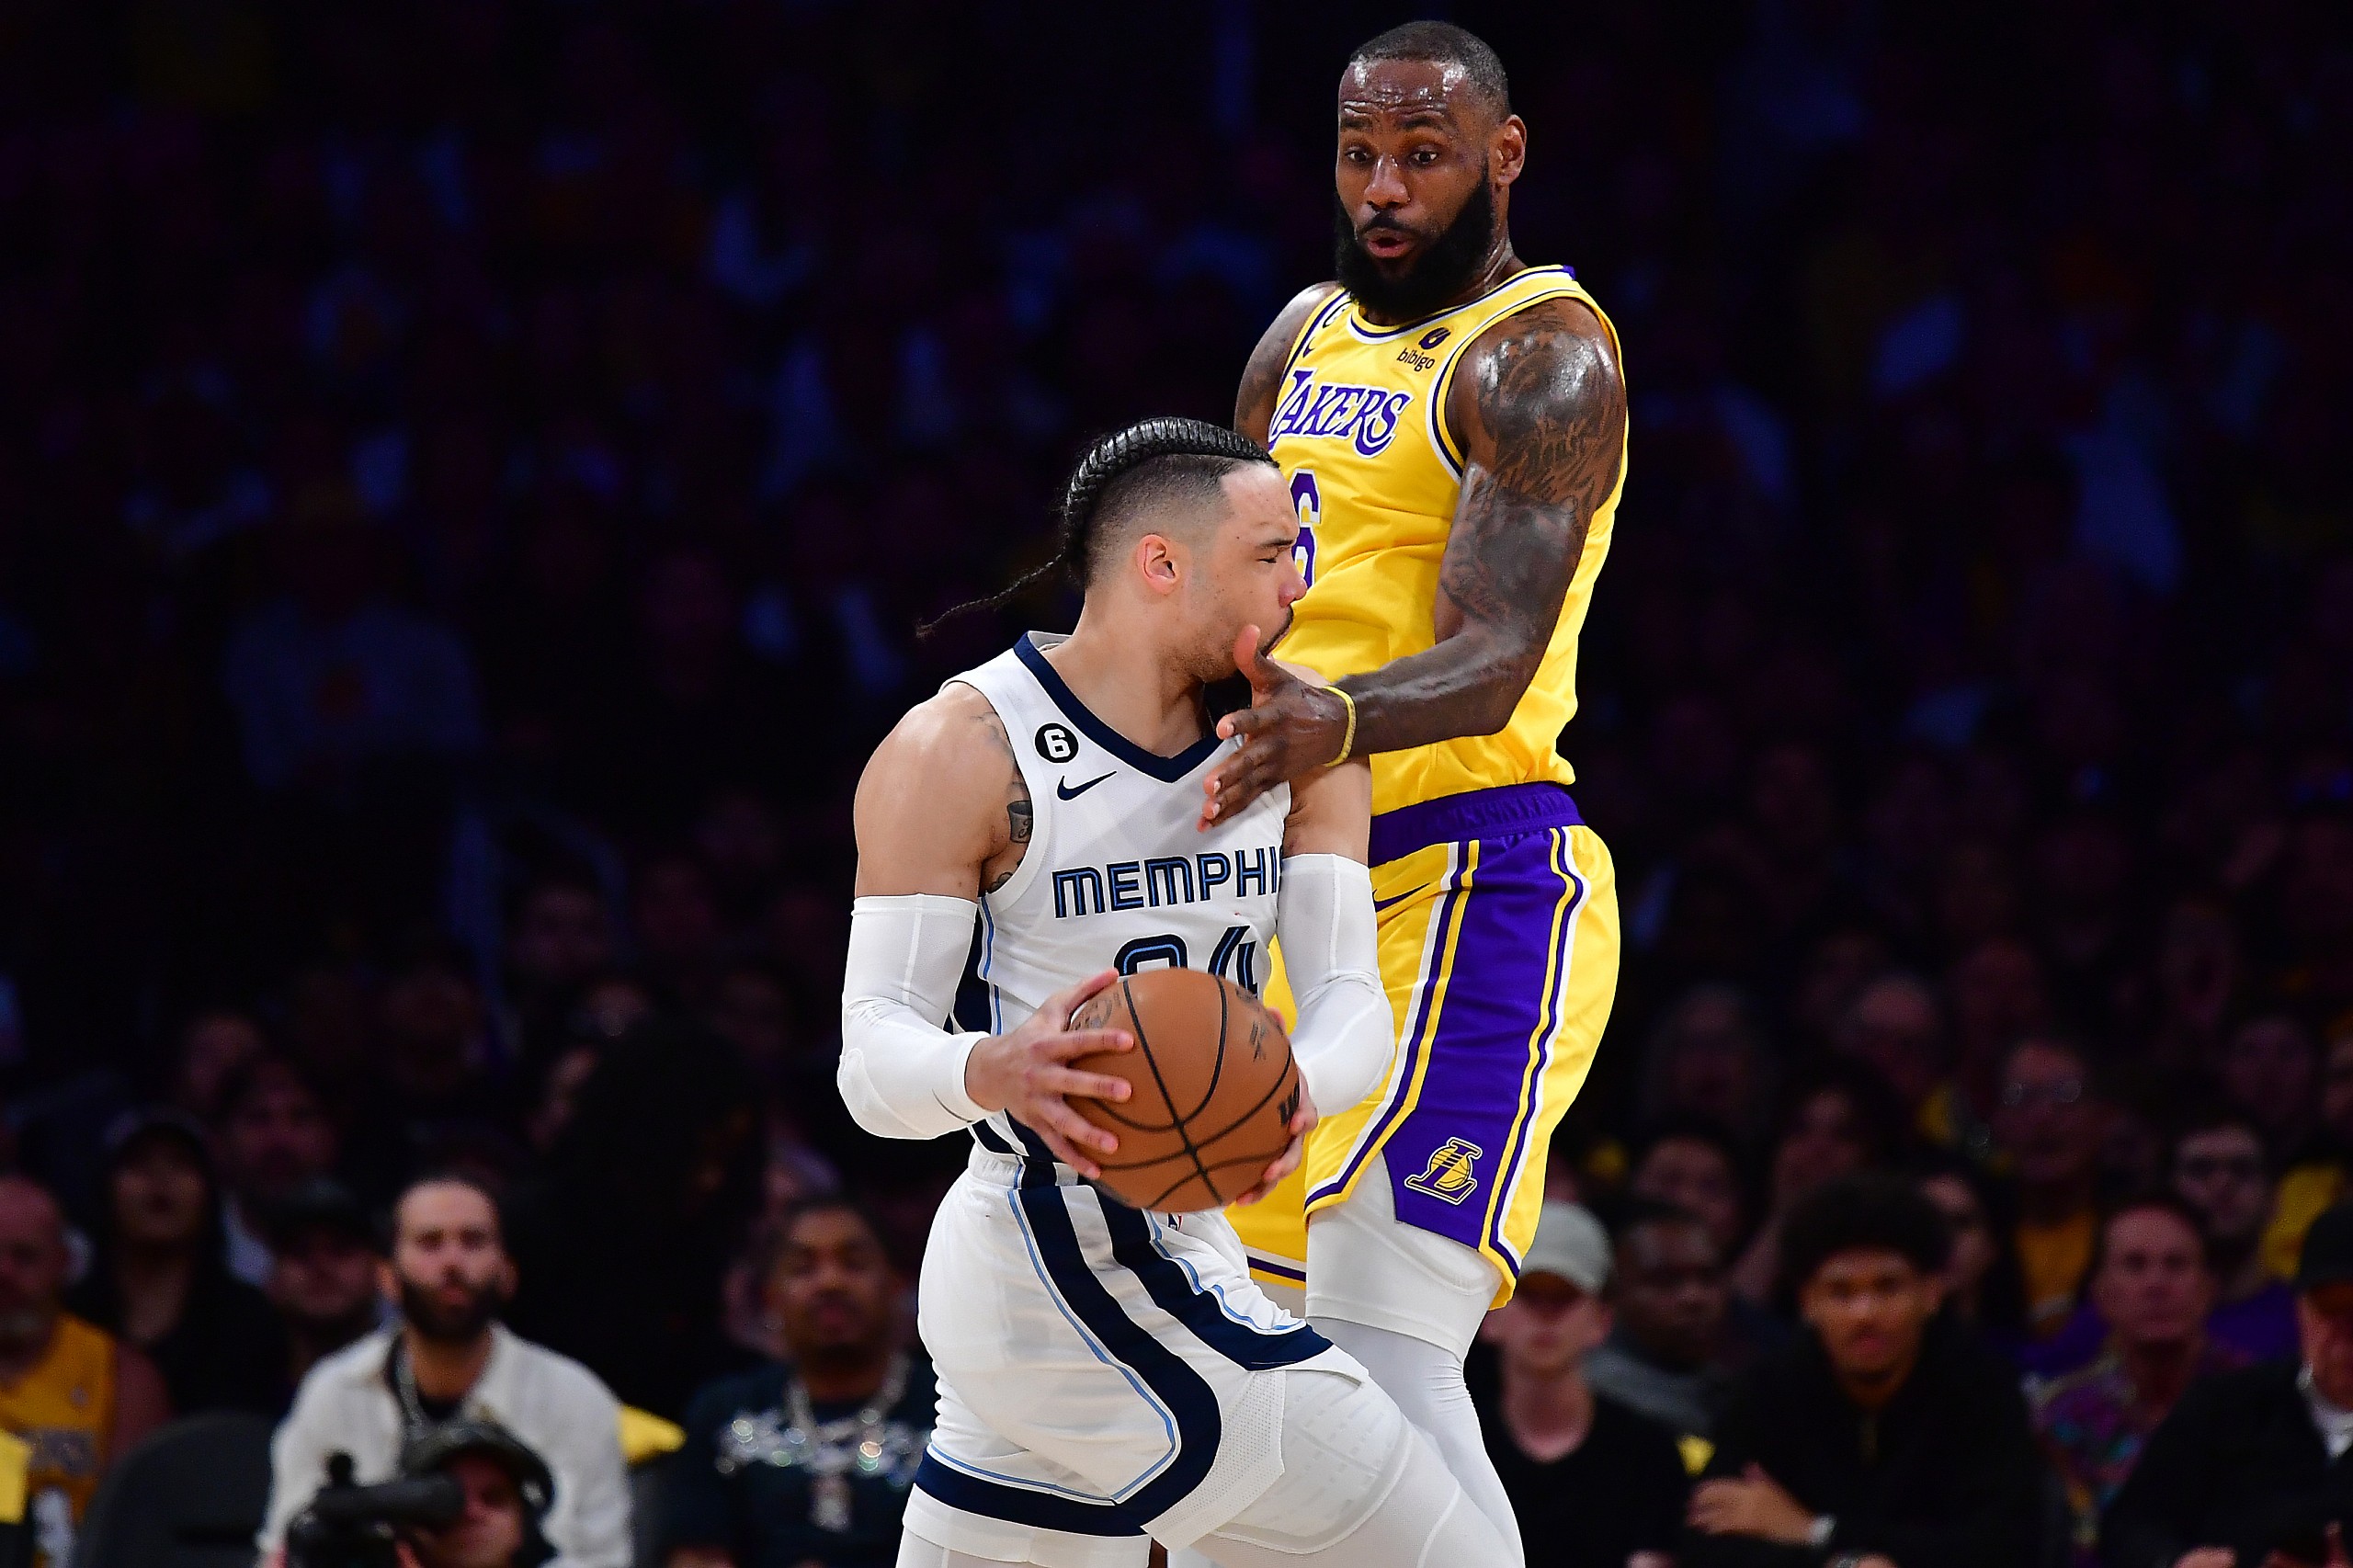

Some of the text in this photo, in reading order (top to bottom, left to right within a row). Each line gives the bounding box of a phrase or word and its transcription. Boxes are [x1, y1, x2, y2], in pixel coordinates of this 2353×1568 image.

[1396, 347, 1436, 372] bibigo
[1043, 728, 1071, 759] 6
[1051, 845, 1283, 919] MEMPHI
